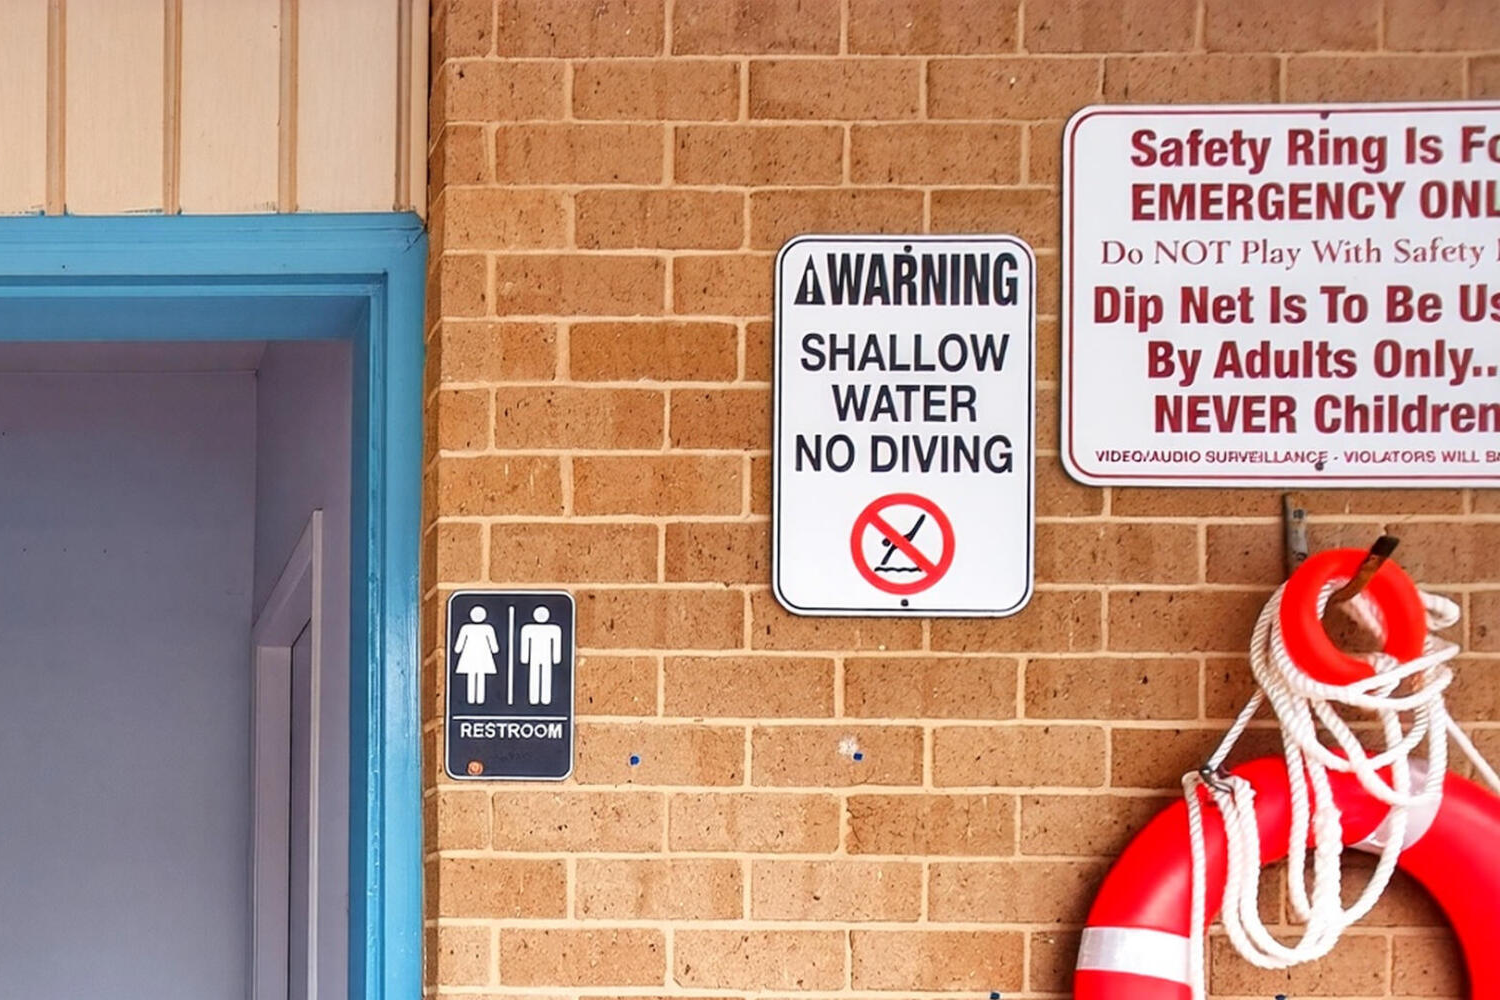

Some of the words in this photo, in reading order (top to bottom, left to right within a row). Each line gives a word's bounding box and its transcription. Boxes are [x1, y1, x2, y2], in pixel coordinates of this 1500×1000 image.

[1131, 129, 1271, 175] Safety
[1288, 128, 1387, 174] Ring
[1406, 127, 1443, 164] Is
[1132, 181, 1405, 221] EMERGENCY
[1420, 180, 1500, 219] ONL
[1102, 241, 1143, 264] Do
[1155, 241, 1231, 264] NOT
[1242, 239, 1300, 270] Play
[1312, 238, 1381, 263] With
[1395, 237, 1484, 268] Safety
[827, 253, 1018, 306] WARNING
[1094, 286, 1163, 333] Dip
[1181, 286, 1254, 324] Net
[1270, 286, 1307, 324] Is
[1320, 286, 1368, 323] To
[1386, 285, 1442, 323] Be
[801, 333, 1010, 372] SHALLOW
[1148, 341, 1202, 387] By
[1213, 341, 1357, 379] Adults
[832, 384, 976, 422] WATER
[1155, 395, 1296, 433] NEVER
[1314, 394, 1500, 434] Children
[796, 434, 855, 472] NO
[871, 435, 1012, 473] DIVING
[1096, 450, 1201, 463] VIDEO/AUDIO
[1206, 451, 1327, 464] SURVEILLANCE
[1344, 451, 1436, 463] VIOLATORS
[1442, 451, 1479, 462] WILL
[461, 723, 562, 738] RESTROOM
